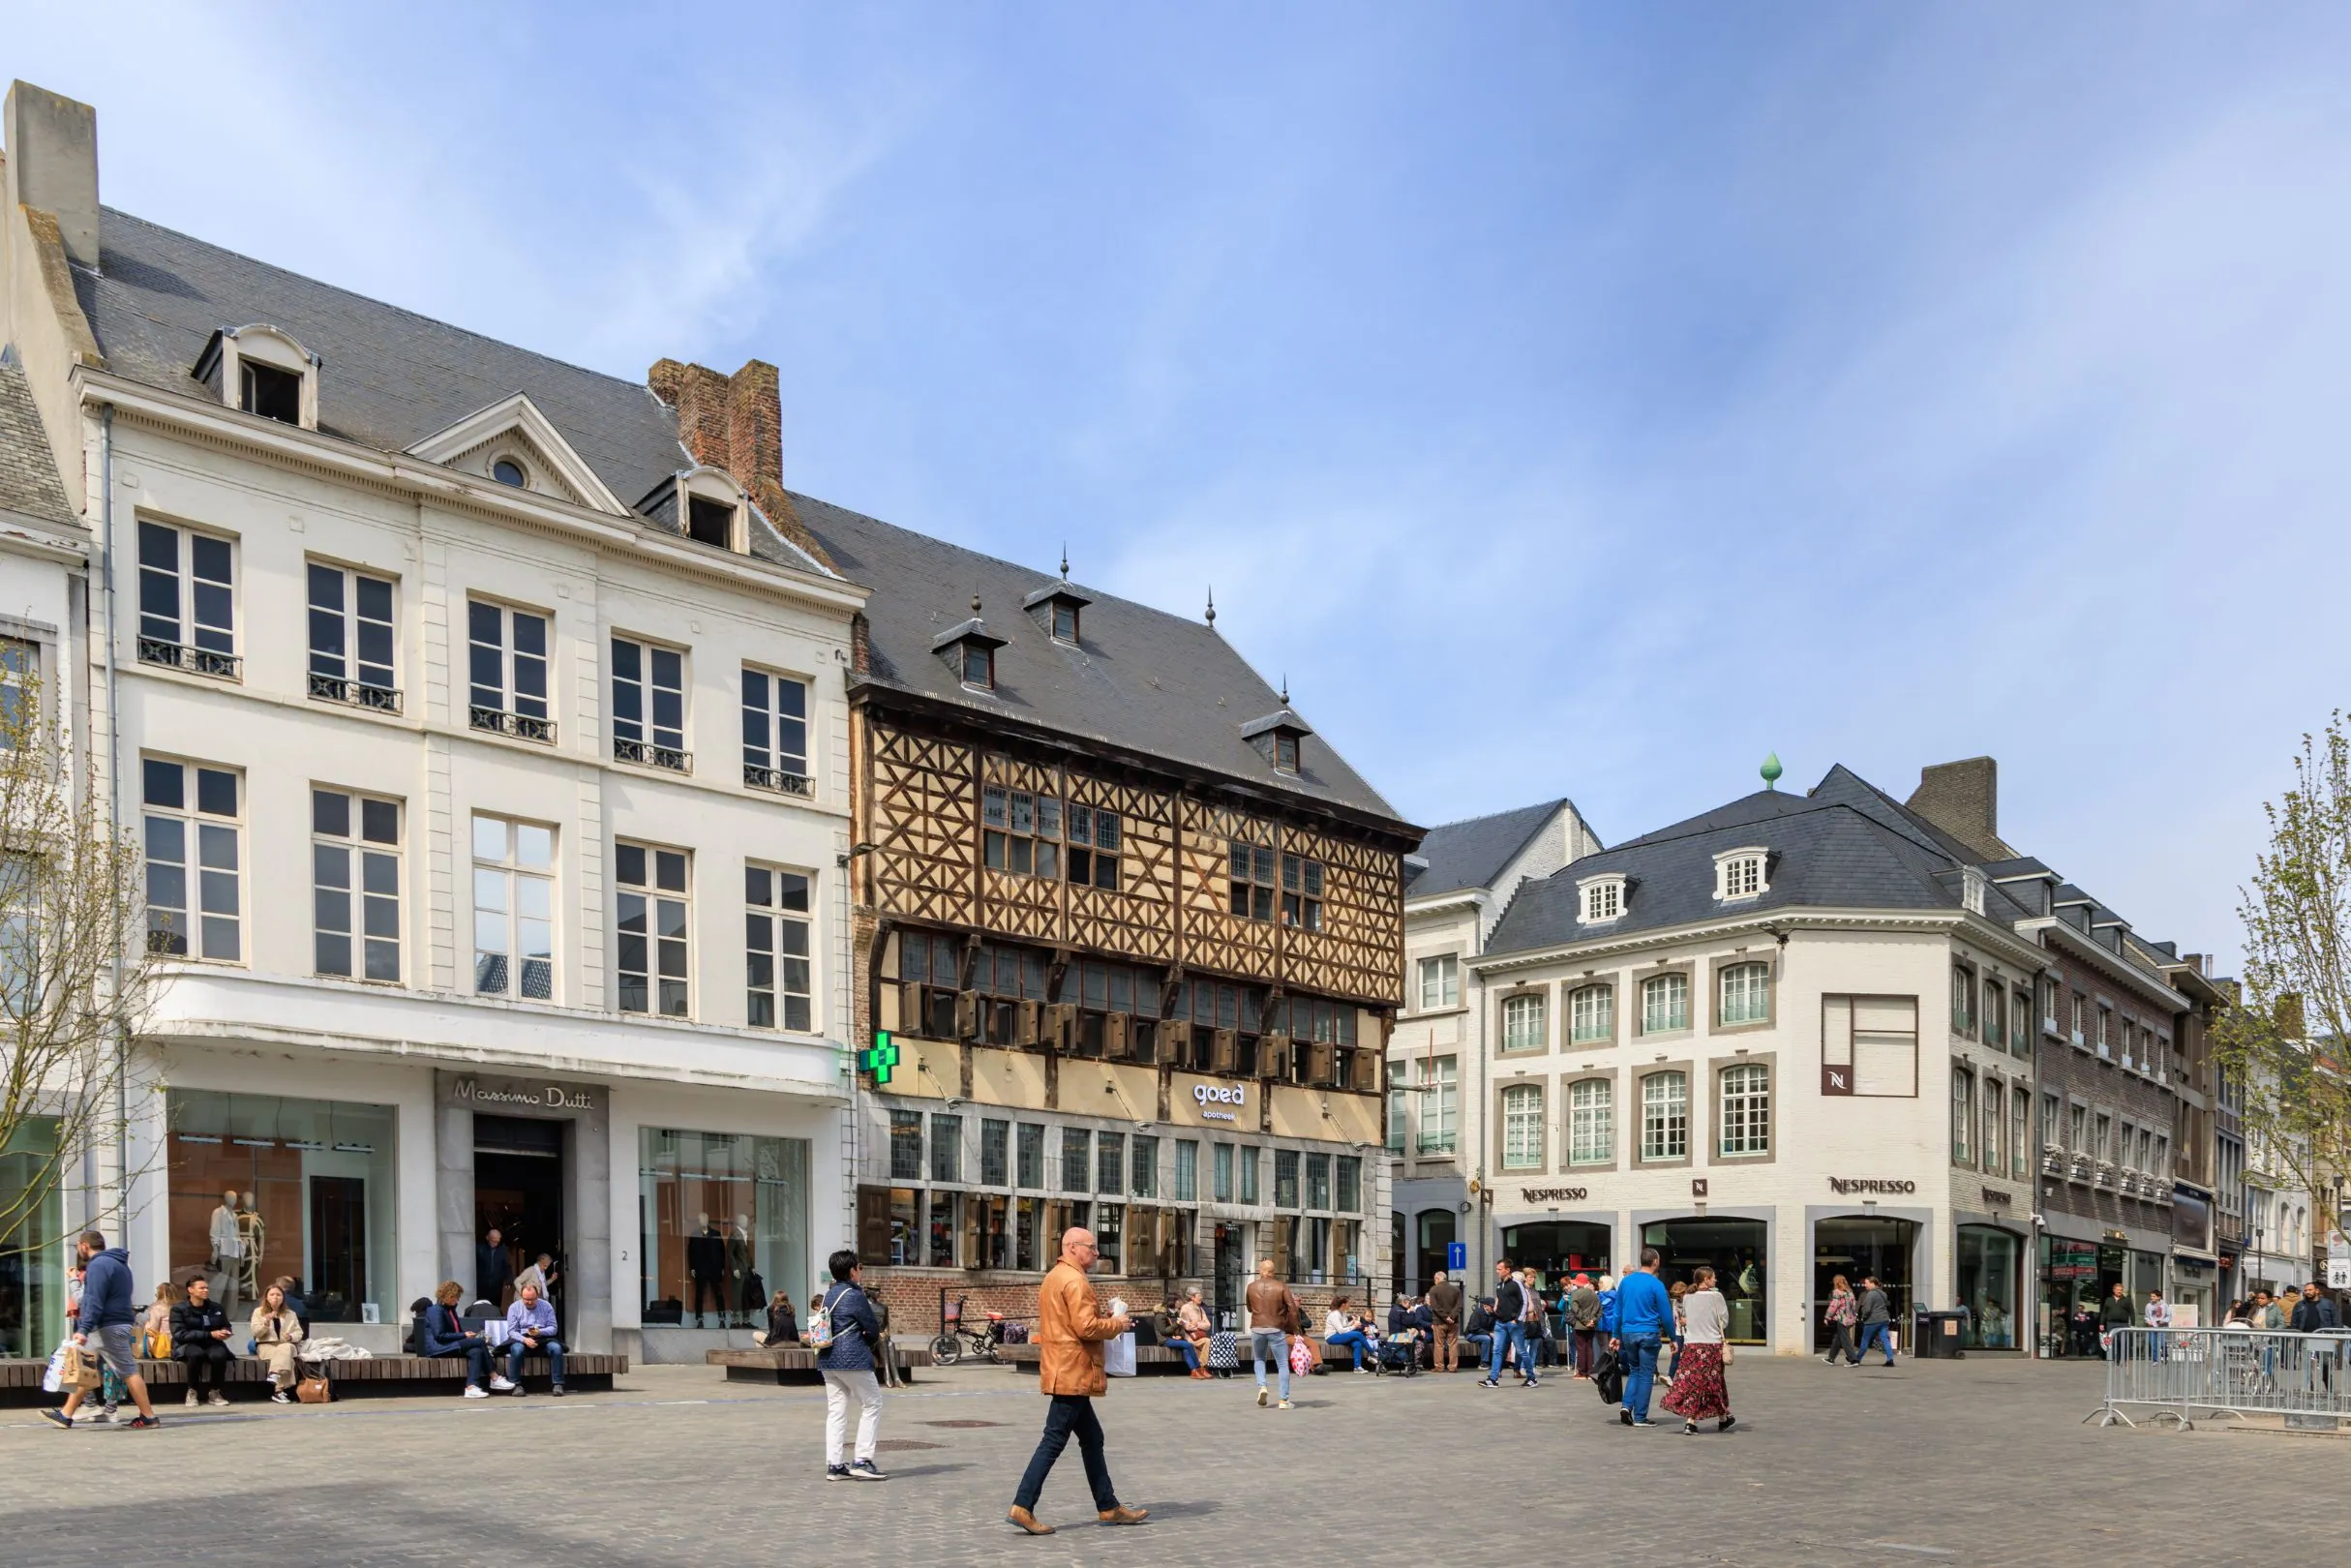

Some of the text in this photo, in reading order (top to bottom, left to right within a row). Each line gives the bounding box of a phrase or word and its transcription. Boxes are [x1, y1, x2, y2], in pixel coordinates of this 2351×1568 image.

[1827, 1070, 1847, 1089] N
[454, 1079, 595, 1109] Massimo Dutti
[1193, 1084, 1245, 1106] goed
[1202, 1110, 1235, 1121] apotheek
[1696, 1181, 1704, 1191] N
[1827, 1176, 1915, 1195] NESPRESSO
[1521, 1187, 1587, 1204] NESPRESSO
[621, 1250, 628, 1261] 2
